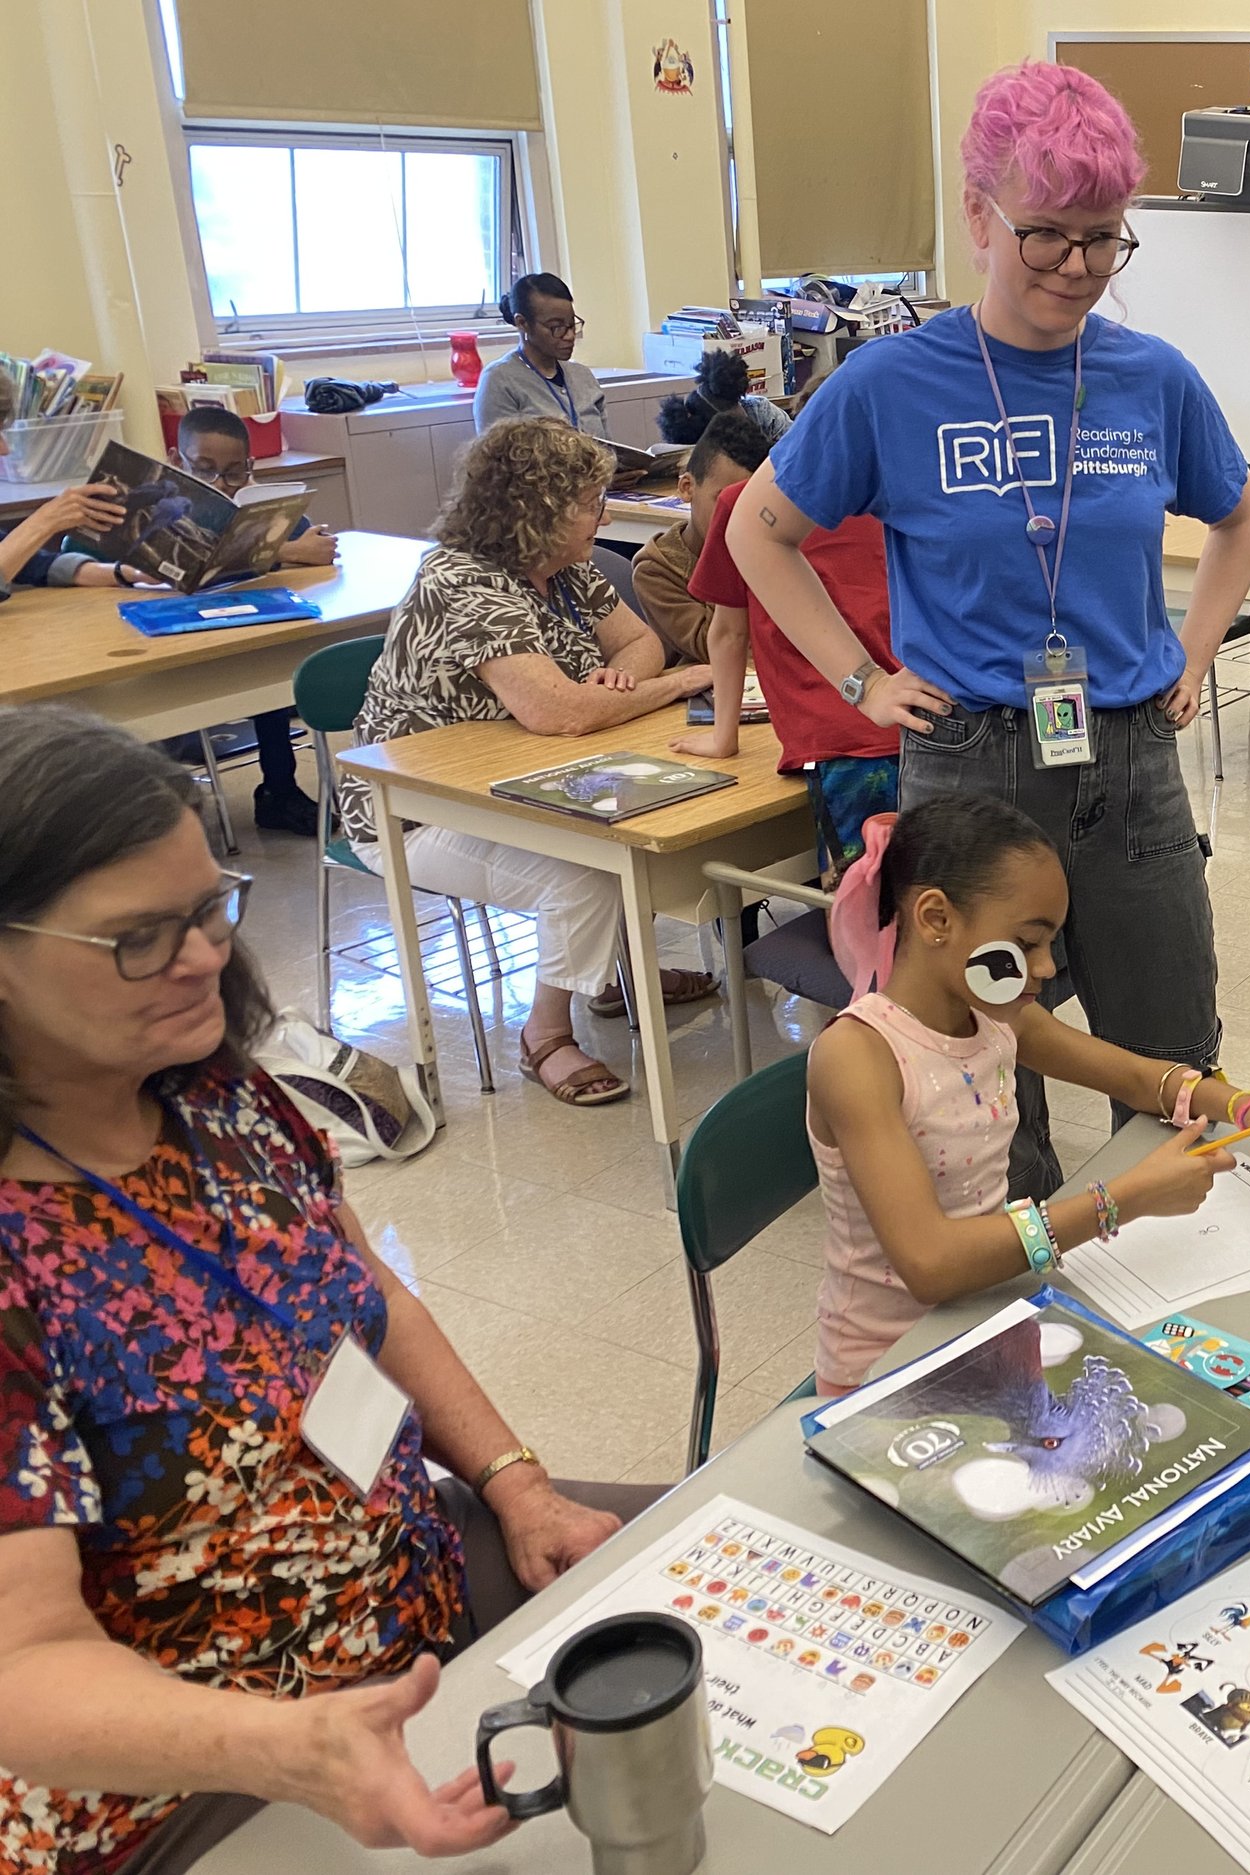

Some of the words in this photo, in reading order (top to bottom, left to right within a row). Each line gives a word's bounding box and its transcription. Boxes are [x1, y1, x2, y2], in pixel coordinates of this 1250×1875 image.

[953, 430, 1041, 482] RIF
[1072, 462, 1148, 477] Pittsburgh
[905, 1429, 953, 1458] 70
[1122, 1437, 1226, 1507] NATIONAL
[723, 1522, 737, 1532] Z
[1052, 1503, 1124, 1560] AVIARY
[742, 1531, 755, 1542] Y
[763, 1538, 775, 1550] X
[780, 1547, 796, 1559] W
[802, 1556, 814, 1566] V
[821, 1564, 835, 1575] U
[842, 1572, 854, 1583] T
[862, 1580, 876, 1591] S
[884, 1588, 897, 1599] R
[903, 1592, 918, 1607] Q
[924, 1602, 939, 1614] P
[946, 1608, 960, 1621] O
[967, 1617, 982, 1631] N
[706, 1675, 741, 1695] their
[721, 1705, 757, 1729] What
[1189, 1723, 1215, 1745] BRAVE
